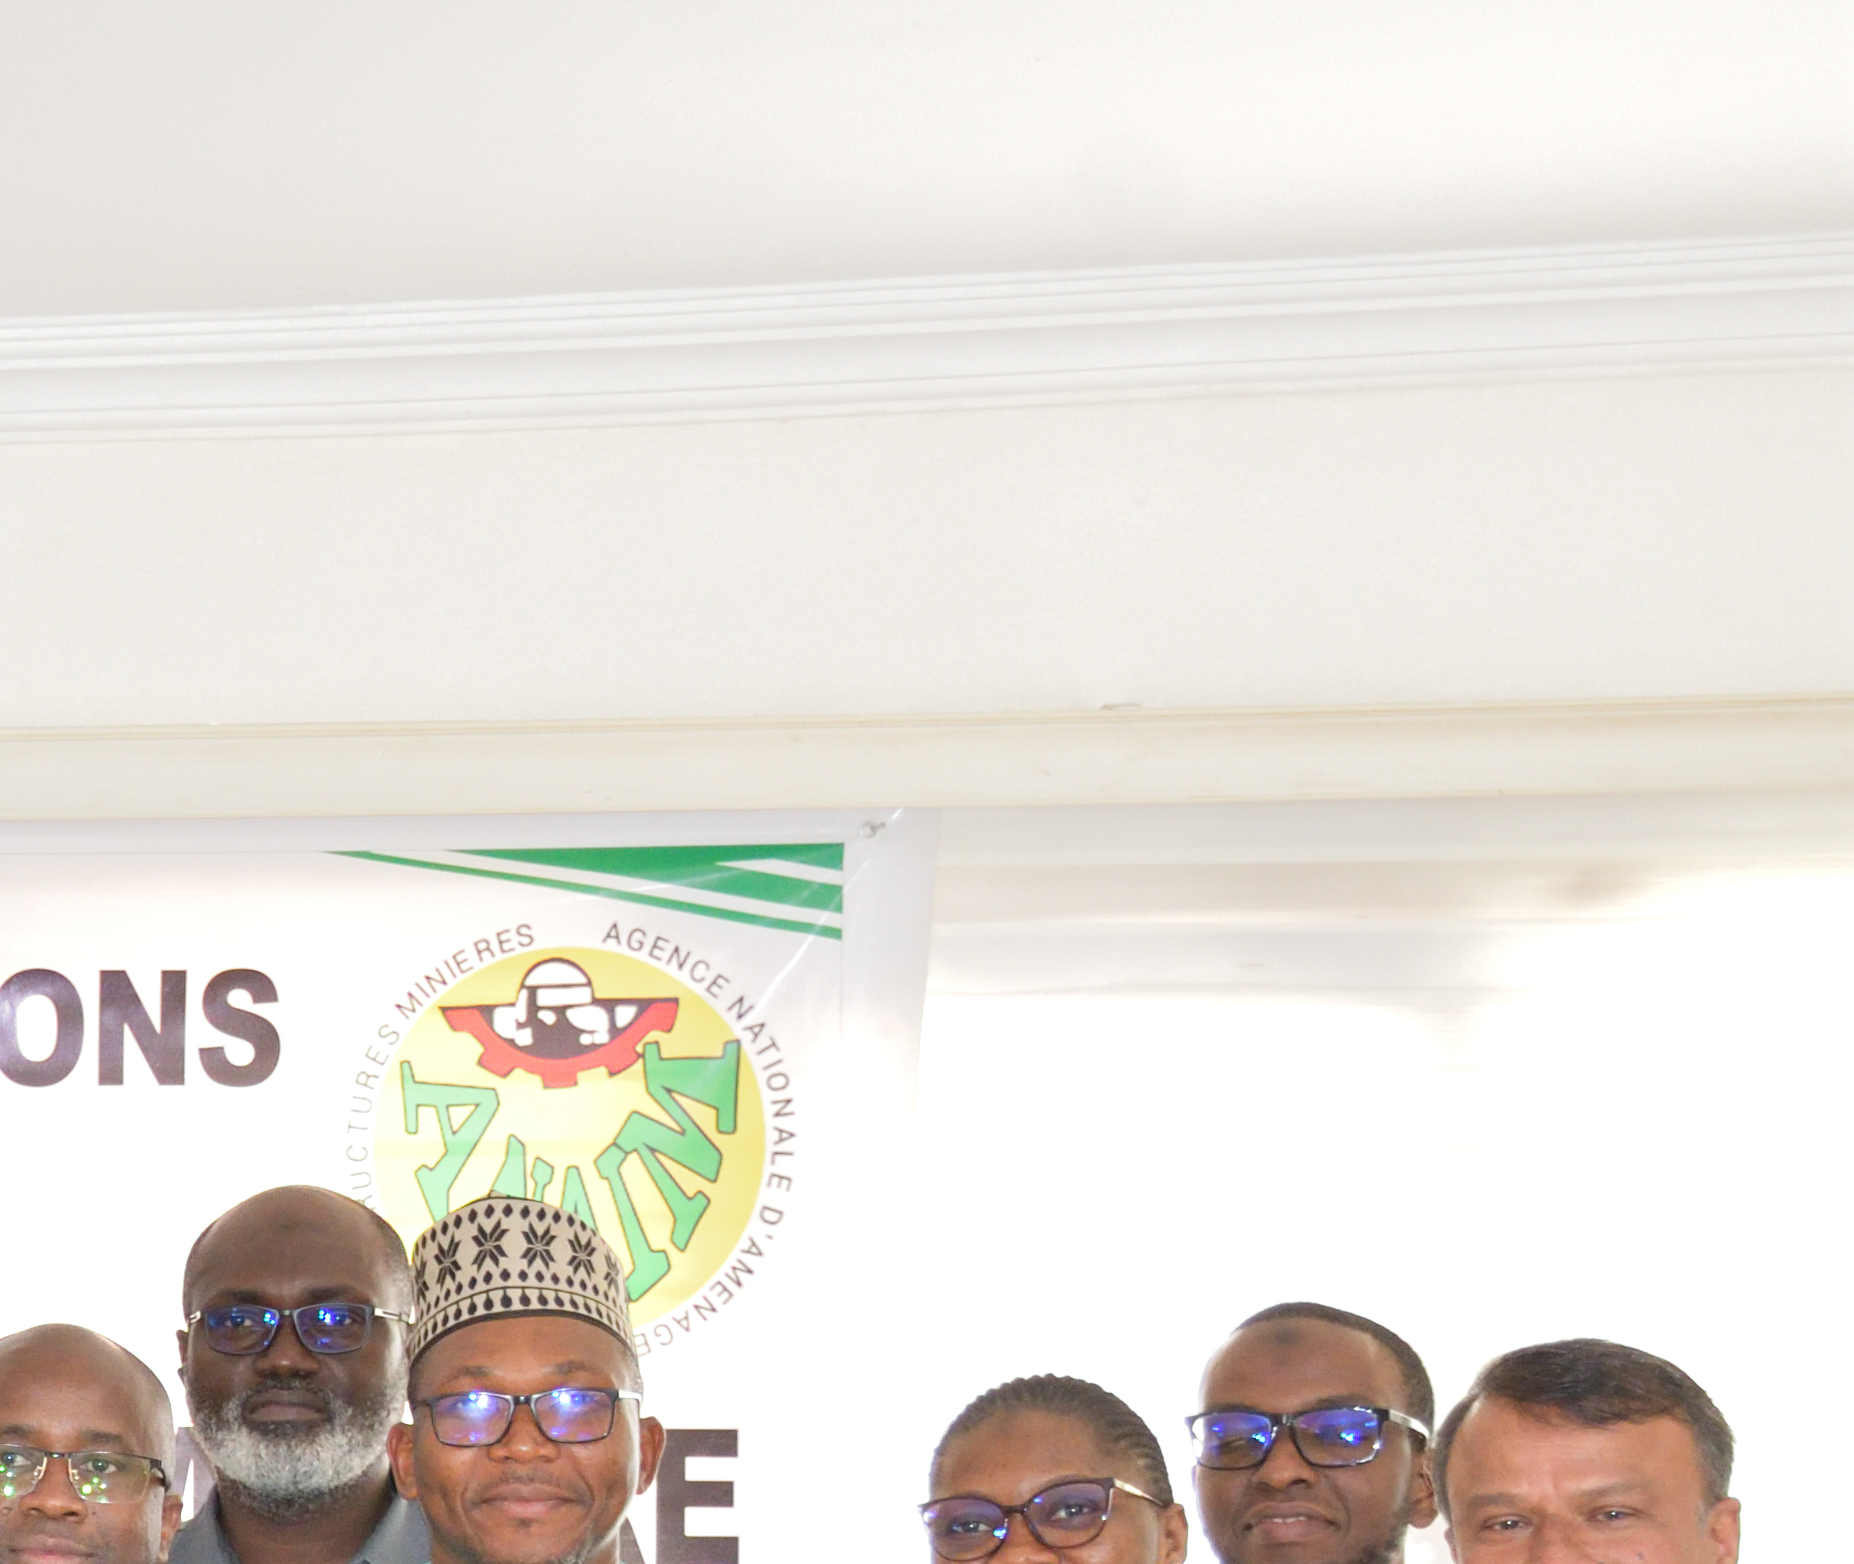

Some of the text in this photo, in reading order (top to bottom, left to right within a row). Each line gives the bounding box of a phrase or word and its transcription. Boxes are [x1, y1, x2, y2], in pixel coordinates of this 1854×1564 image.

[394, 923, 535, 1020] MINIERES
[601, 922, 730, 999] AGENCE
[726, 994, 798, 1194] NATIONALE
[634, 1210, 785, 1357] D'AMENAGE
